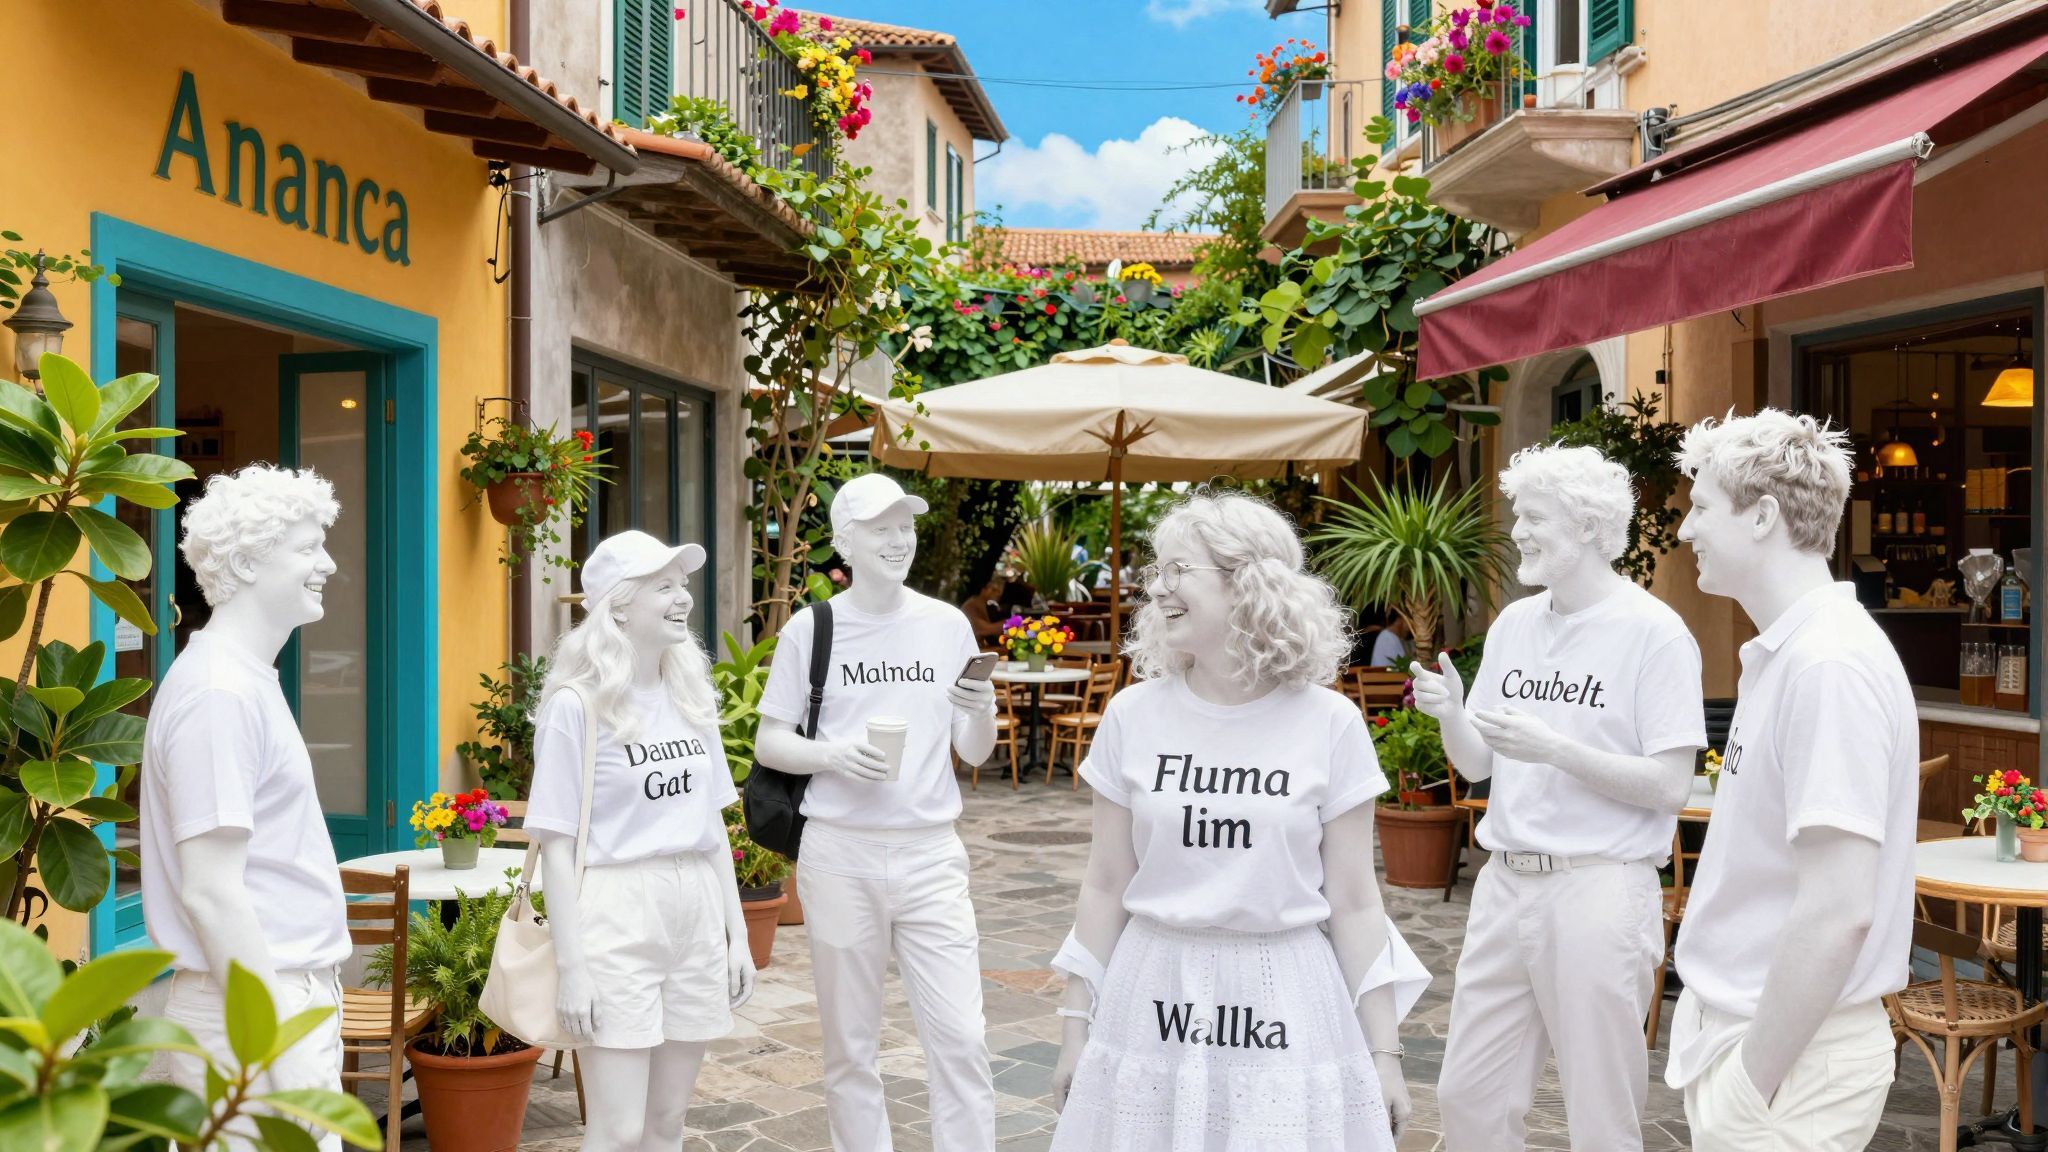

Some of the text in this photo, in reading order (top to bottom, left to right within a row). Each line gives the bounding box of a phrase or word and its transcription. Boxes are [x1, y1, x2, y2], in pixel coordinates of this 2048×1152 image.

[154, 69, 411, 268] Ananca
[1501, 669, 1605, 709] Coubelt.
[623, 738, 706, 768] Daima
[1151, 753, 1290, 797] Fluma
[644, 768, 692, 801] Gat
[1182, 804, 1253, 849] lim
[1152, 999, 1290, 1050] Wallka
